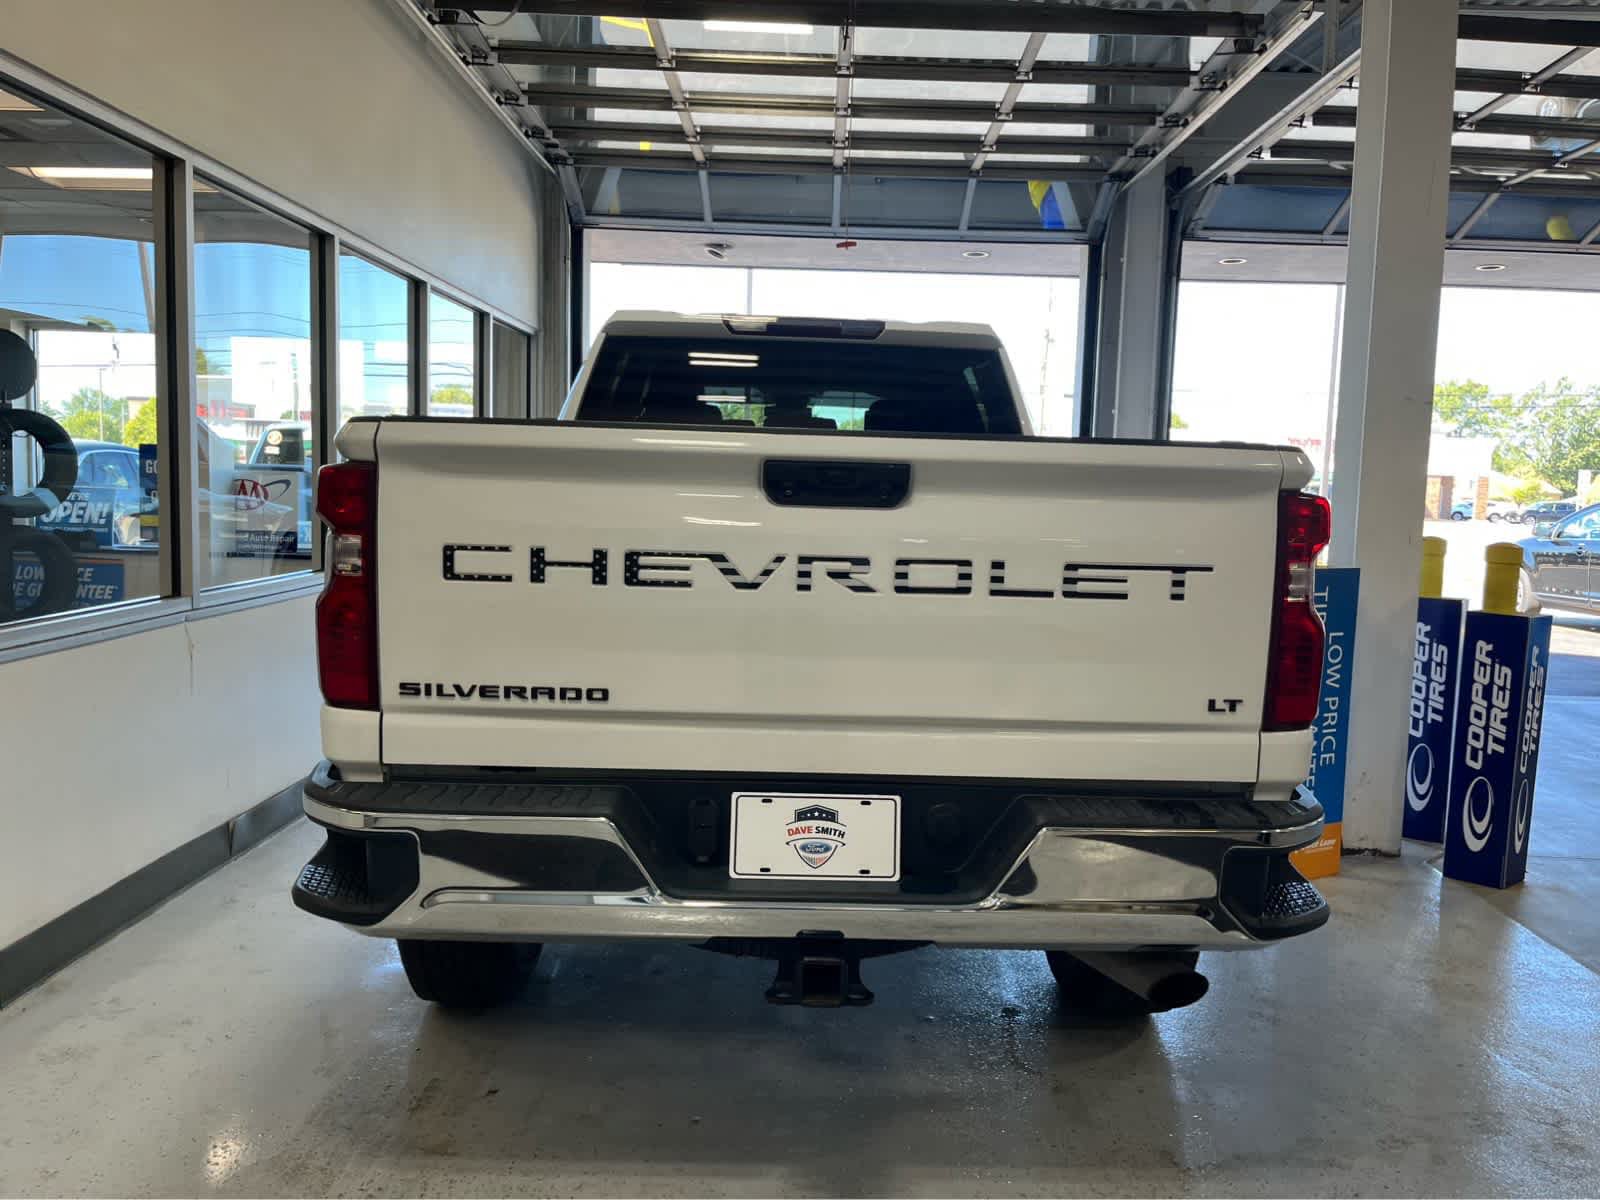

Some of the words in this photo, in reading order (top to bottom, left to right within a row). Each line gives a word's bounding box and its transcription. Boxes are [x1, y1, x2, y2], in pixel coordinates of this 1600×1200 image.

[40, 501, 108, 524] OPEN!
[443, 543, 1214, 601] CHEVROLET
[398, 682, 609, 702] SILVERADO
[1326, 632, 1344, 688] LOW
[1409, 621, 1431, 738] COOPER
[1427, 642, 1448, 724] TIRES
[1208, 698, 1243, 712] LT
[1320, 697, 1339, 767] PRICE
[1465, 640, 1494, 770] COOPER
[1487, 664, 1512, 755] TIRES
[1519, 645, 1539, 774] COOPER
[1528, 666, 1544, 755] TIRES
[787, 826, 813, 836] DAVE
[815, 826, 845, 838] SMITH
[806, 843, 825, 852] Ford
